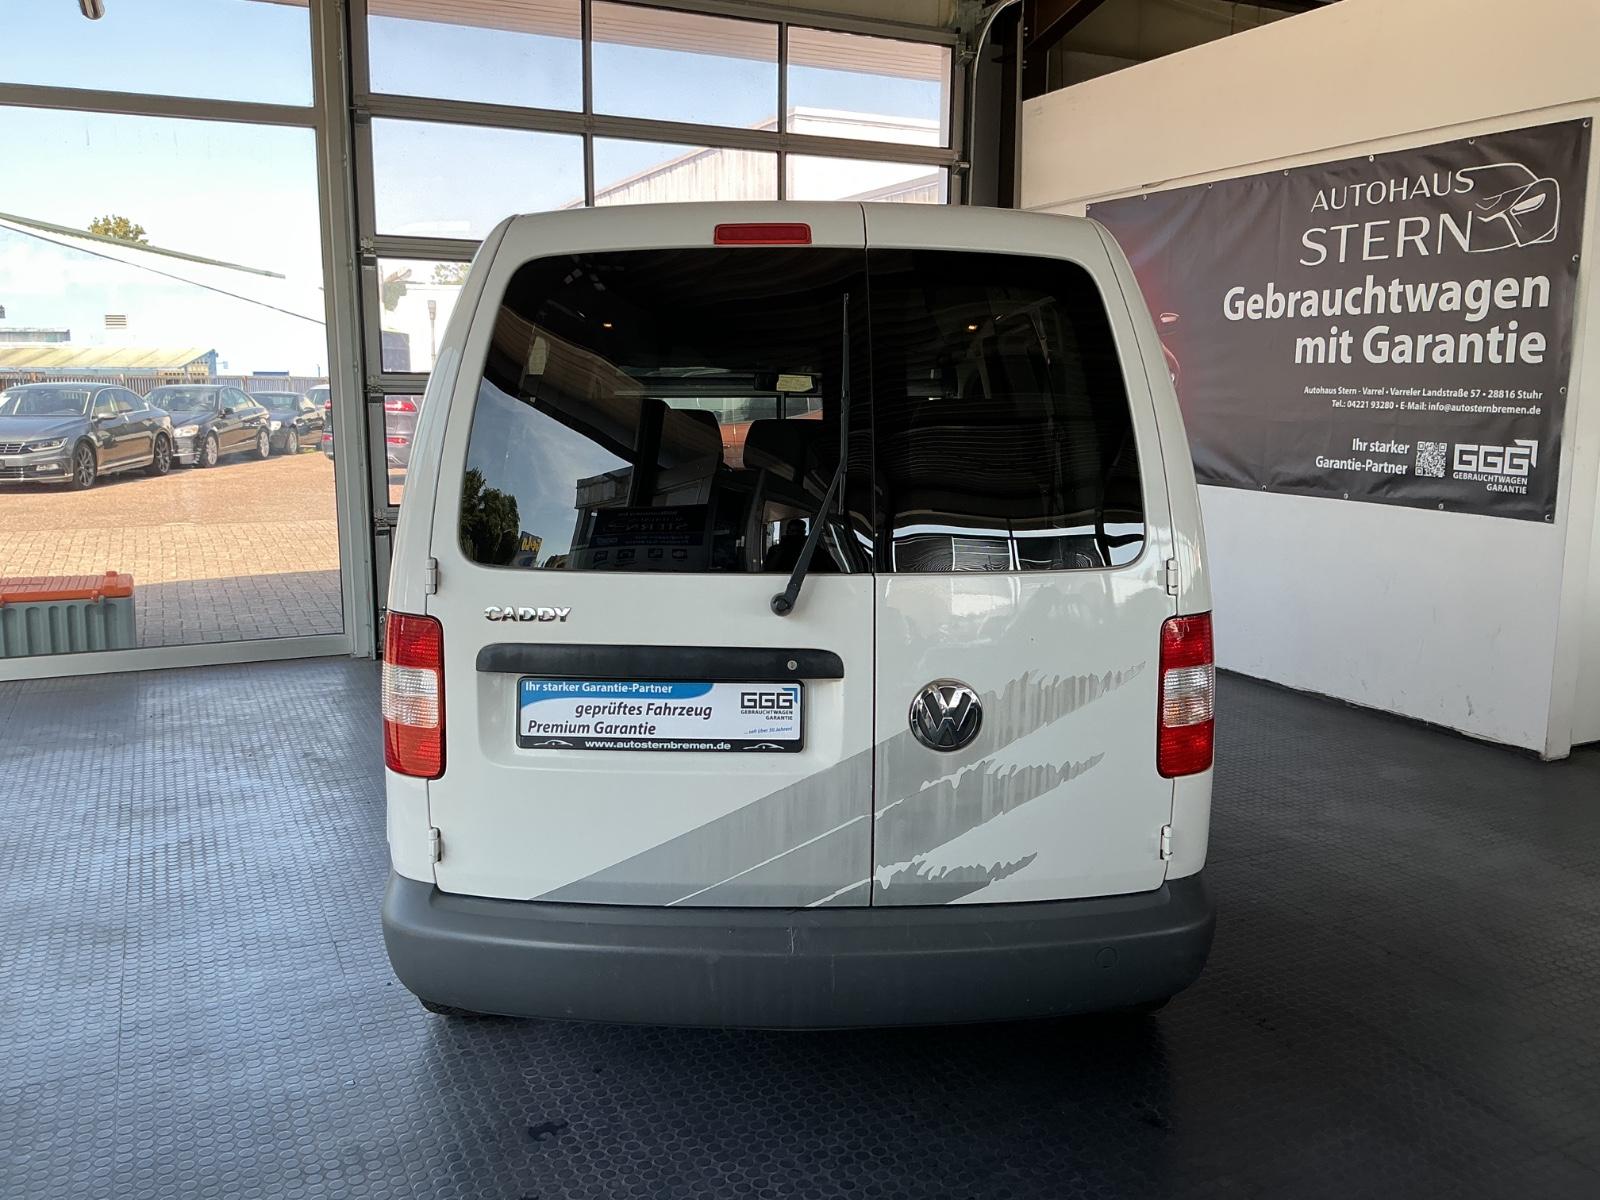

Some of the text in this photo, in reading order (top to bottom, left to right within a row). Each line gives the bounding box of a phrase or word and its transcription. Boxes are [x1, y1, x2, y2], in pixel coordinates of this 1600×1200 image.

[1311, 169, 1475, 213] AUTOHAUS
[1299, 211, 1473, 266] STERN
[1223, 274, 1551, 322] Gebrauchtwagen
[1295, 321, 1547, 364] mit Garantie
[1304, 386, 1337, 395] Autohaus
[1338, 387, 1357, 395] Stern
[1362, 388, 1384, 396] Varrel
[1390, 388, 1421, 396] Varreler
[1422, 388, 1468, 398] Landstraße
[1488, 390, 1516, 399] 28816
[1517, 391, 1542, 399] Stuhr
[1347, 401, 1369, 409] 04221
[1370, 401, 1394, 409] 93280
[1400, 402, 1426, 410] E-Mail:
[1428, 402, 1541, 415] info@autosternbremen.de
[1352, 438, 1410, 454] Ihr starker
[1315, 456, 1408, 475] Garantie-Partner
[1453, 443, 1530, 475] GGG
[1453, 472, 1527, 485] GEBRAUCHTWAGEN
[1486, 483, 1527, 494] GARANTIE
[484, 605, 572, 622] CADDY
[525, 682, 673, 694] Ihr starker Garantie-Partner
[741, 692, 793, 709] GGG
[575, 702, 712, 720] geprüftes Fahrzeug
[528, 720, 656, 735] Premium Garantie
[584, 739, 731, 750] www.autosternbremen.de
